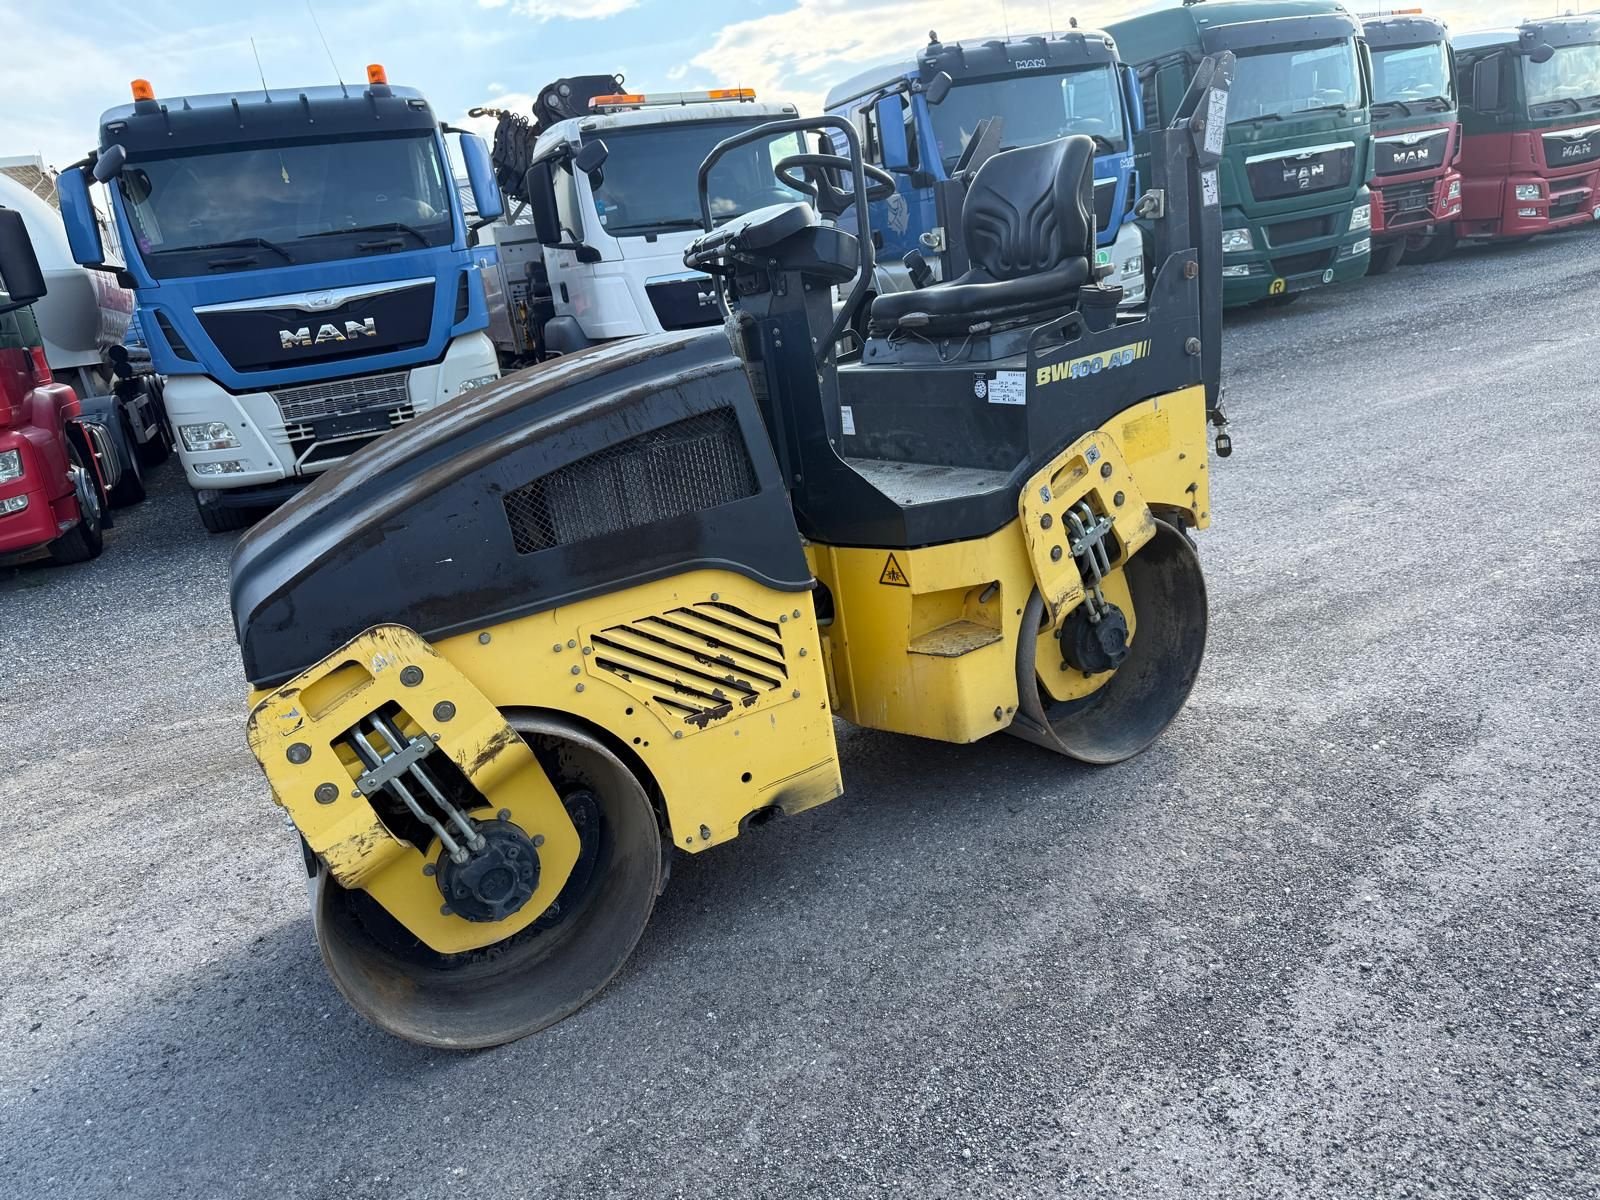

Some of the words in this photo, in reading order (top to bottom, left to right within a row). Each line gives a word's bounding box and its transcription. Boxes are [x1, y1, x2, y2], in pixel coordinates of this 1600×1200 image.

[1015, 58, 1046, 69] MAN
[1393, 148, 1428, 163] MAN
[1562, 142, 1591, 157] MAN
[1273, 281, 1282, 293] R
[279, 317, 377, 349] MAN
[1108, 349, 1135, 370] AD
